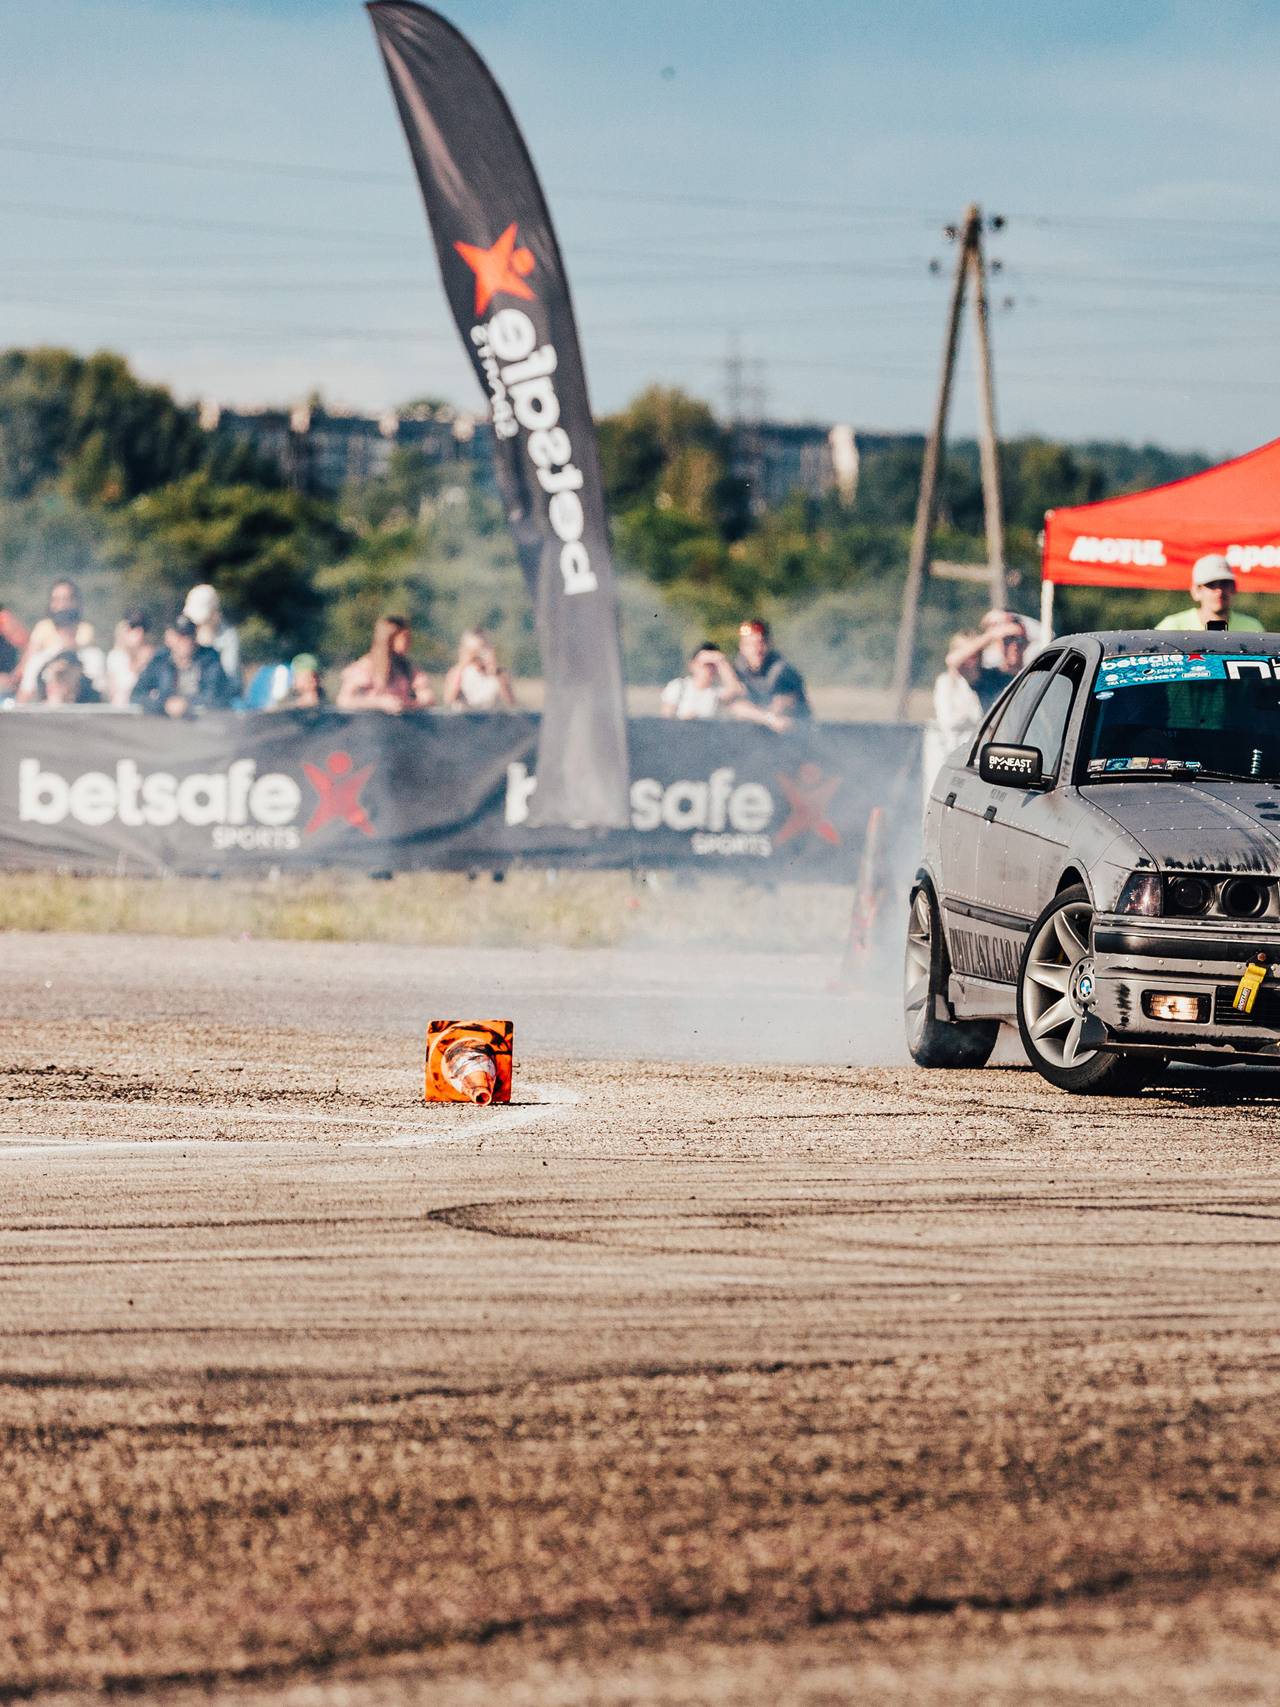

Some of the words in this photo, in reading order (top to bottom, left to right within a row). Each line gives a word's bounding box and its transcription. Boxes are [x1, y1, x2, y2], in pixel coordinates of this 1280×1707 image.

[1069, 536, 1167, 566] MOTUL
[1101, 655, 1184, 671] betsafe
[989, 764, 1032, 774] GARAGE
[19, 758, 301, 826] betsafe
[211, 825, 300, 850] SPORTS
